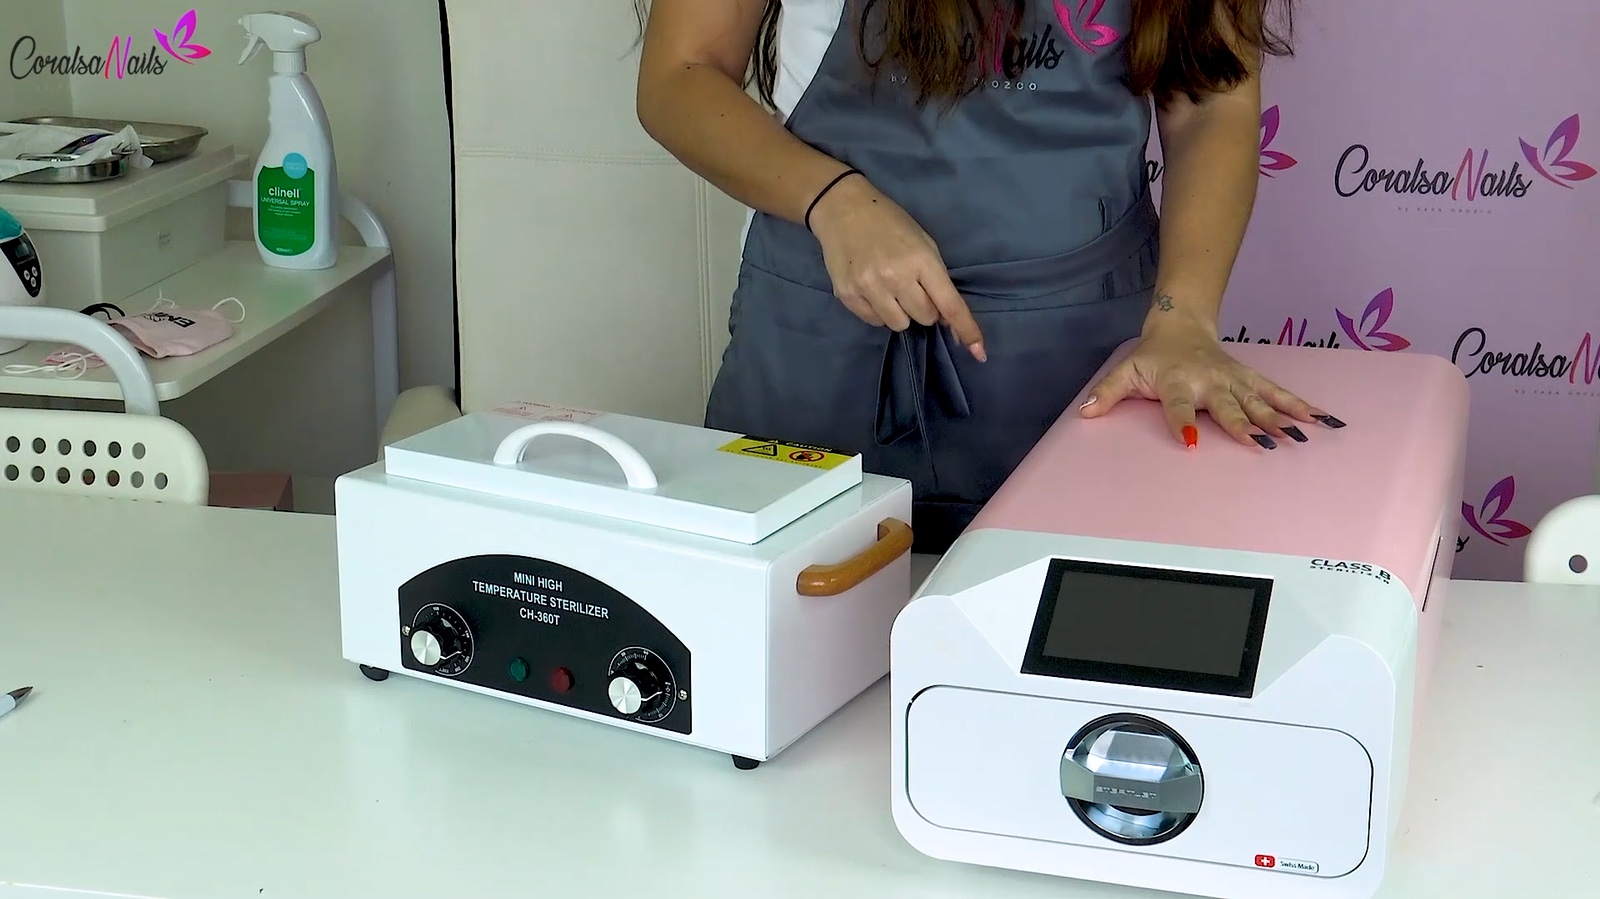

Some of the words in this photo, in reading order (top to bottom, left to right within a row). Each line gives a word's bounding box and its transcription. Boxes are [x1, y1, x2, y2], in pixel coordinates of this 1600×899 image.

[268, 186, 300, 198] clinell
[260, 196, 289, 206] UNIVERSAL
[290, 199, 310, 207] SPRAY
[786, 442, 832, 452] CAUTION
[1310, 558, 1373, 572] CLASS
[1379, 570, 1391, 580] B
[513, 571, 535, 586] MINI
[537, 575, 563, 592] HIGH
[472, 580, 548, 606] TEMPERATURE
[549, 596, 609, 619] STERILIZER
[519, 607, 560, 625] CH-360T
[1280, 860, 1297, 869] Swiss
[1297, 863, 1316, 871] Made
